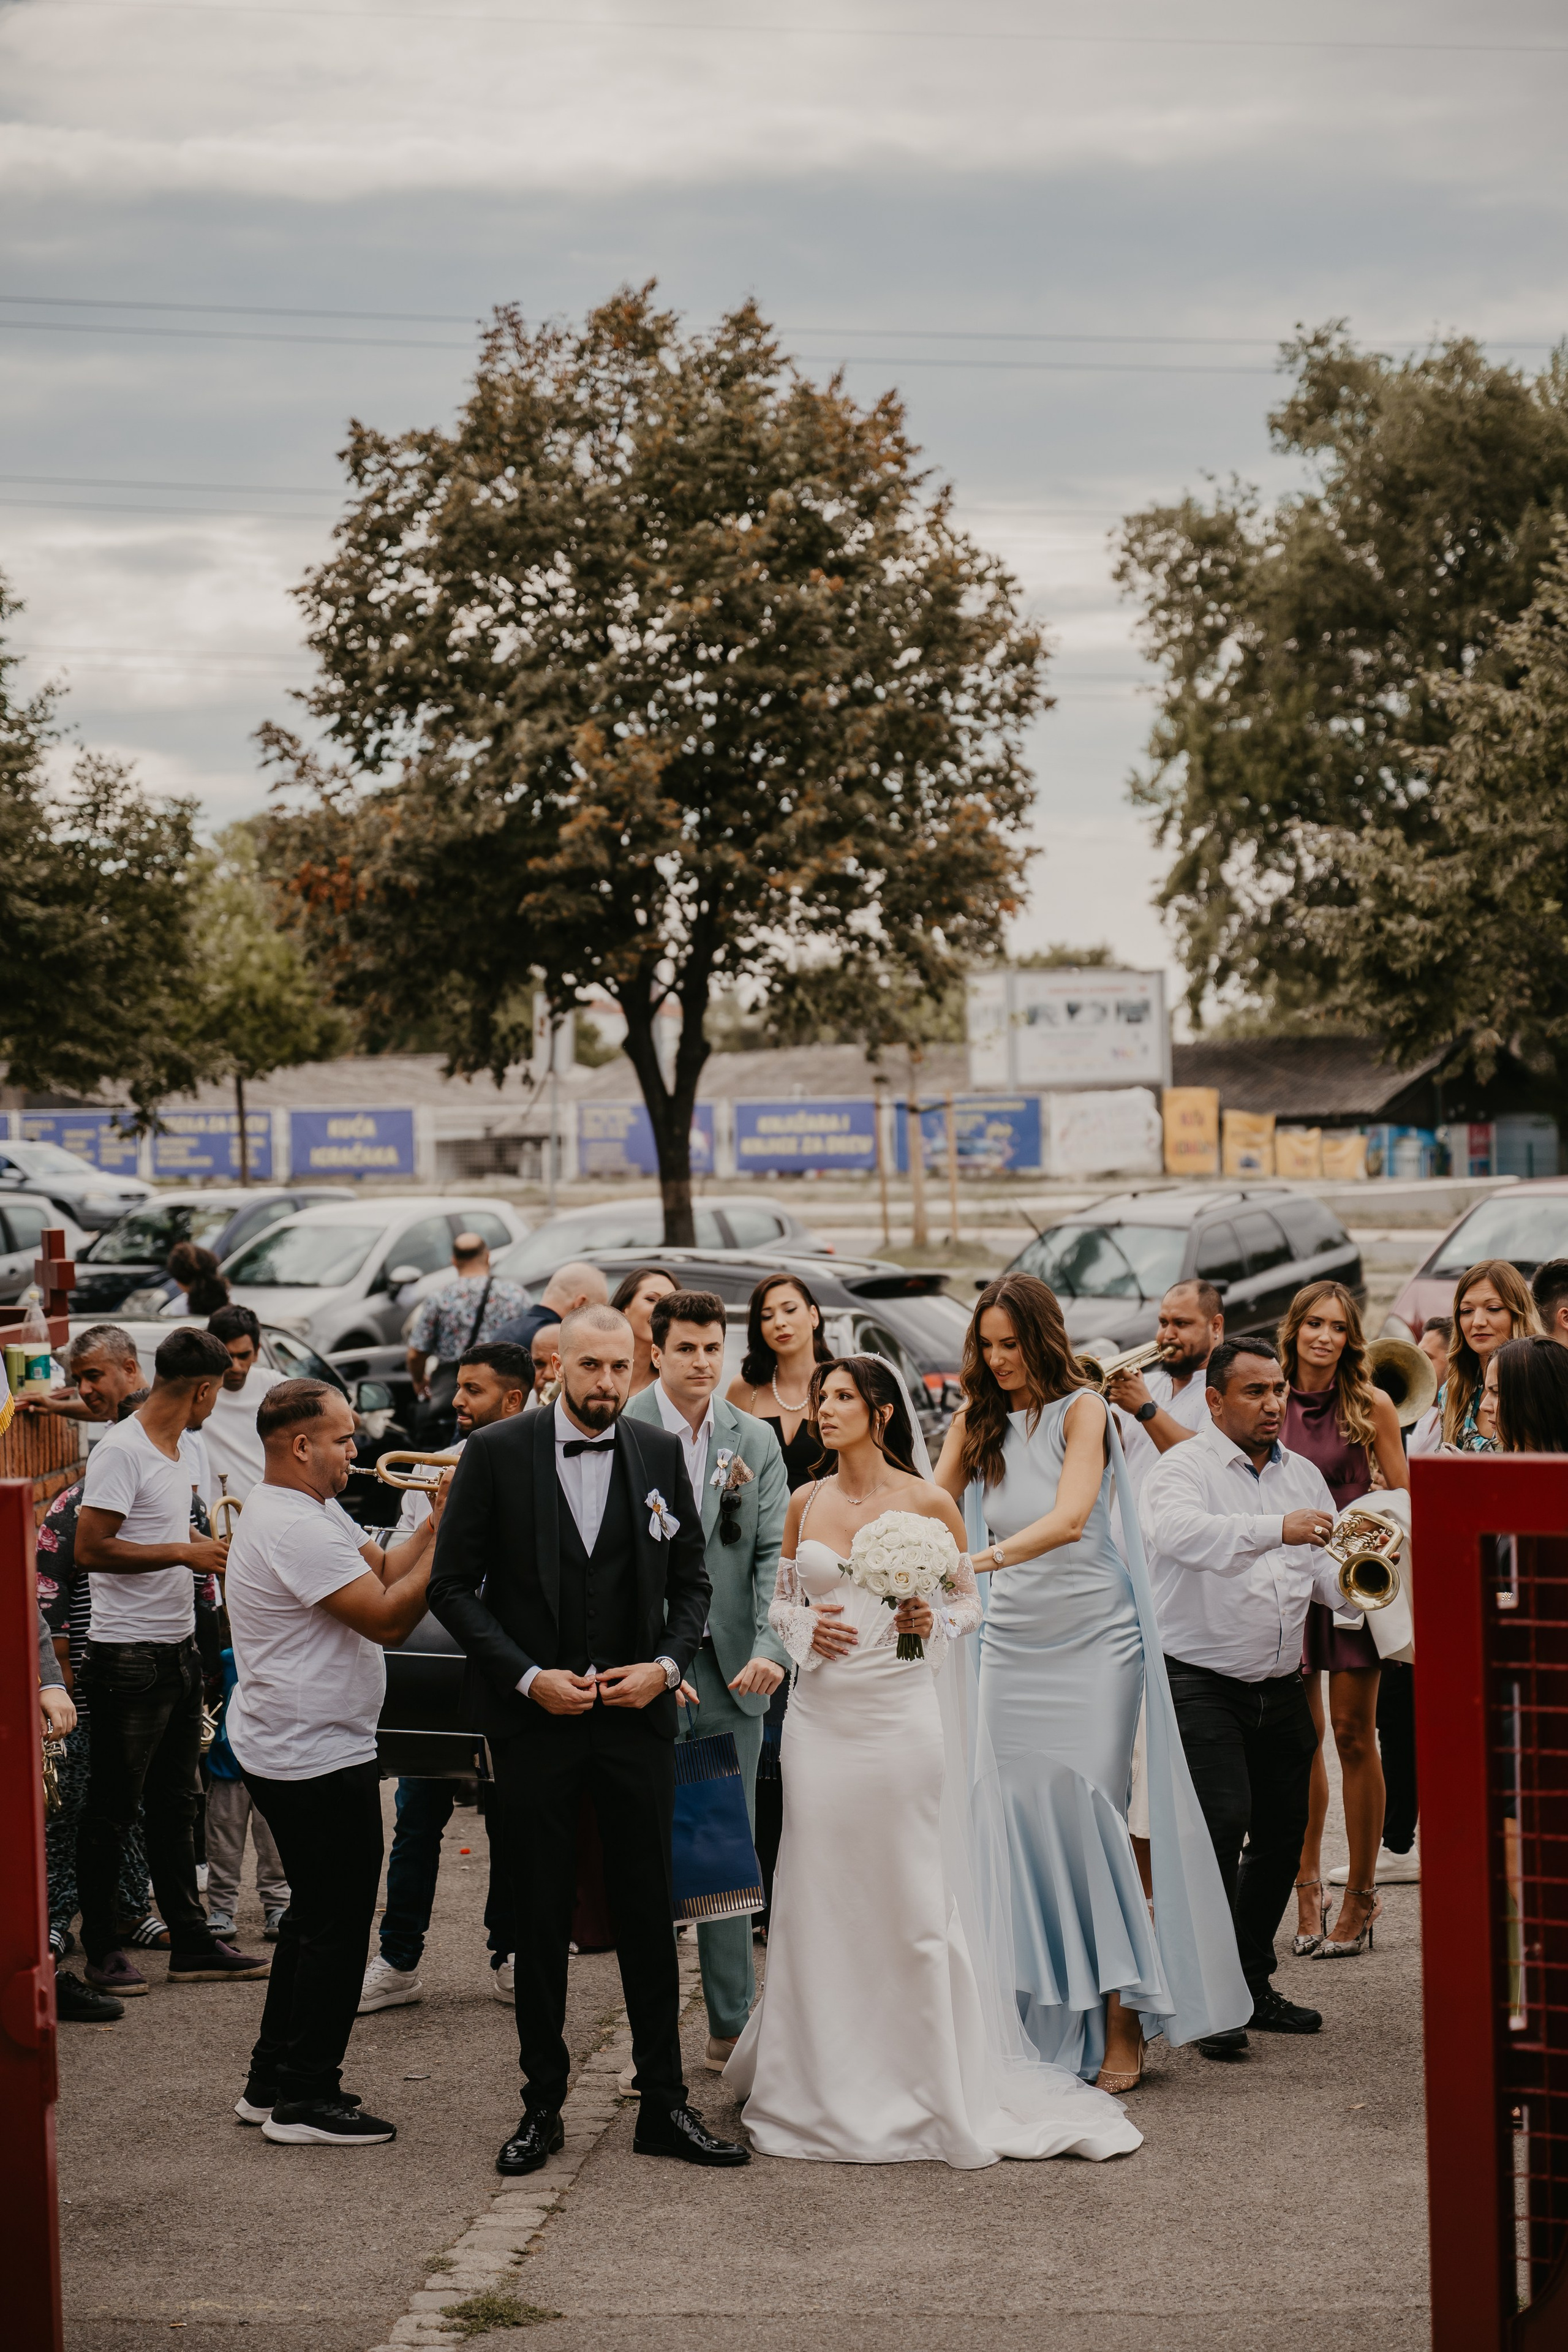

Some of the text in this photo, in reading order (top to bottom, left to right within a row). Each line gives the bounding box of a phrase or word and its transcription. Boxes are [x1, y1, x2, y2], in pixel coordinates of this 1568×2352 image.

[327, 1112, 377, 1139] KUĆA
[309, 1142, 399, 1167] IGRAČAKA
[801, 1136, 823, 1155] ZA
[826, 1135, 873, 1155] DECU
